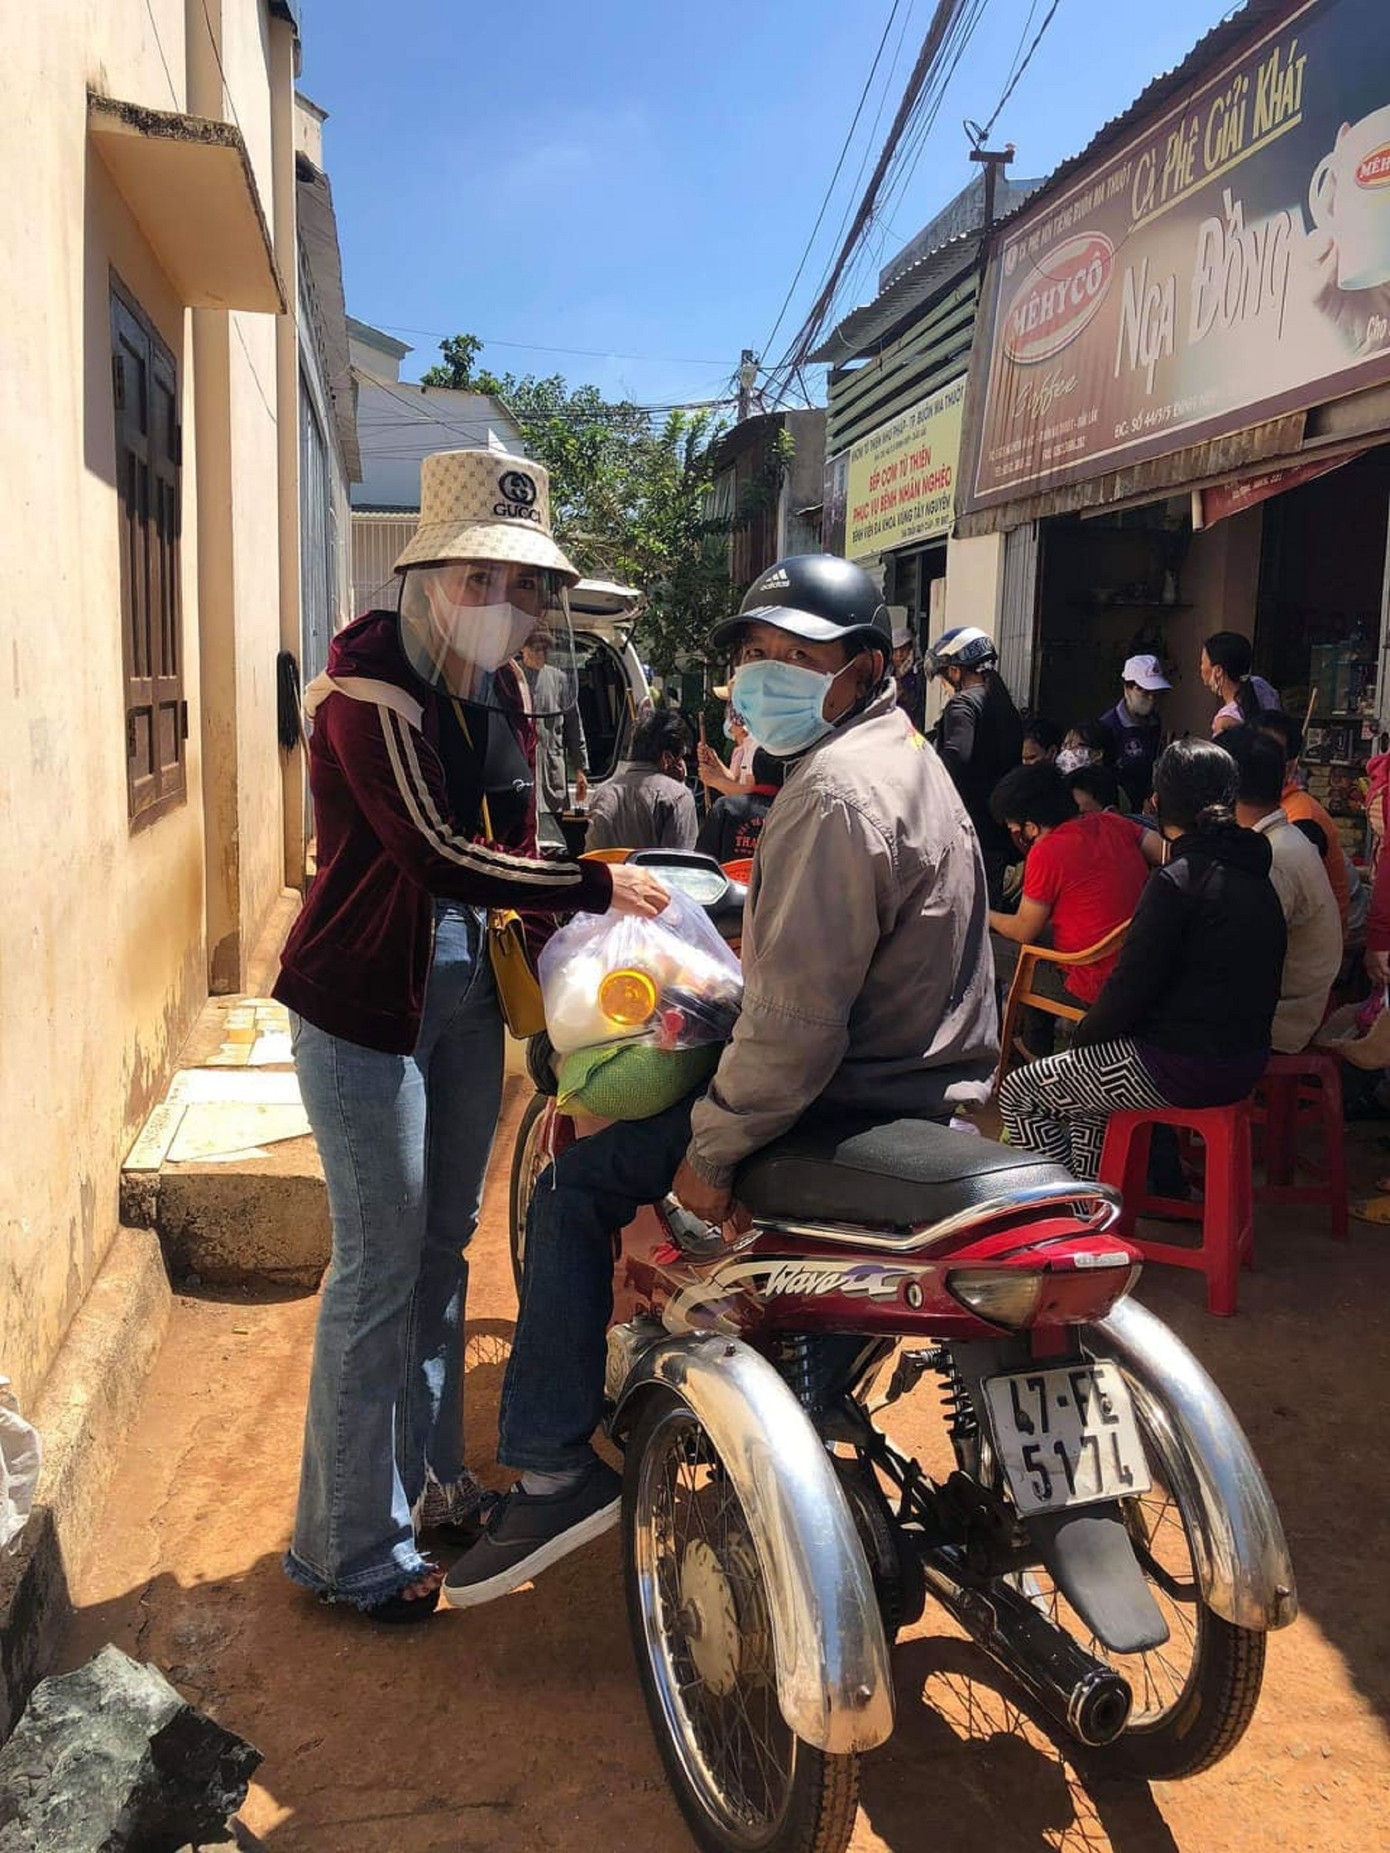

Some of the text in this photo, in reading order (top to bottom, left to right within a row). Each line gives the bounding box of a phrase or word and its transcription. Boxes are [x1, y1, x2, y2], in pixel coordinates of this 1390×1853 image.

[1161, 115, 1198, 202] PHÊ
[1253, 39, 1307, 140] KHÁT
[493, 502, 542, 525] GUCCI
[764, 1264, 848, 1298] Wave
[1022, 1431, 1134, 1501] 5174
